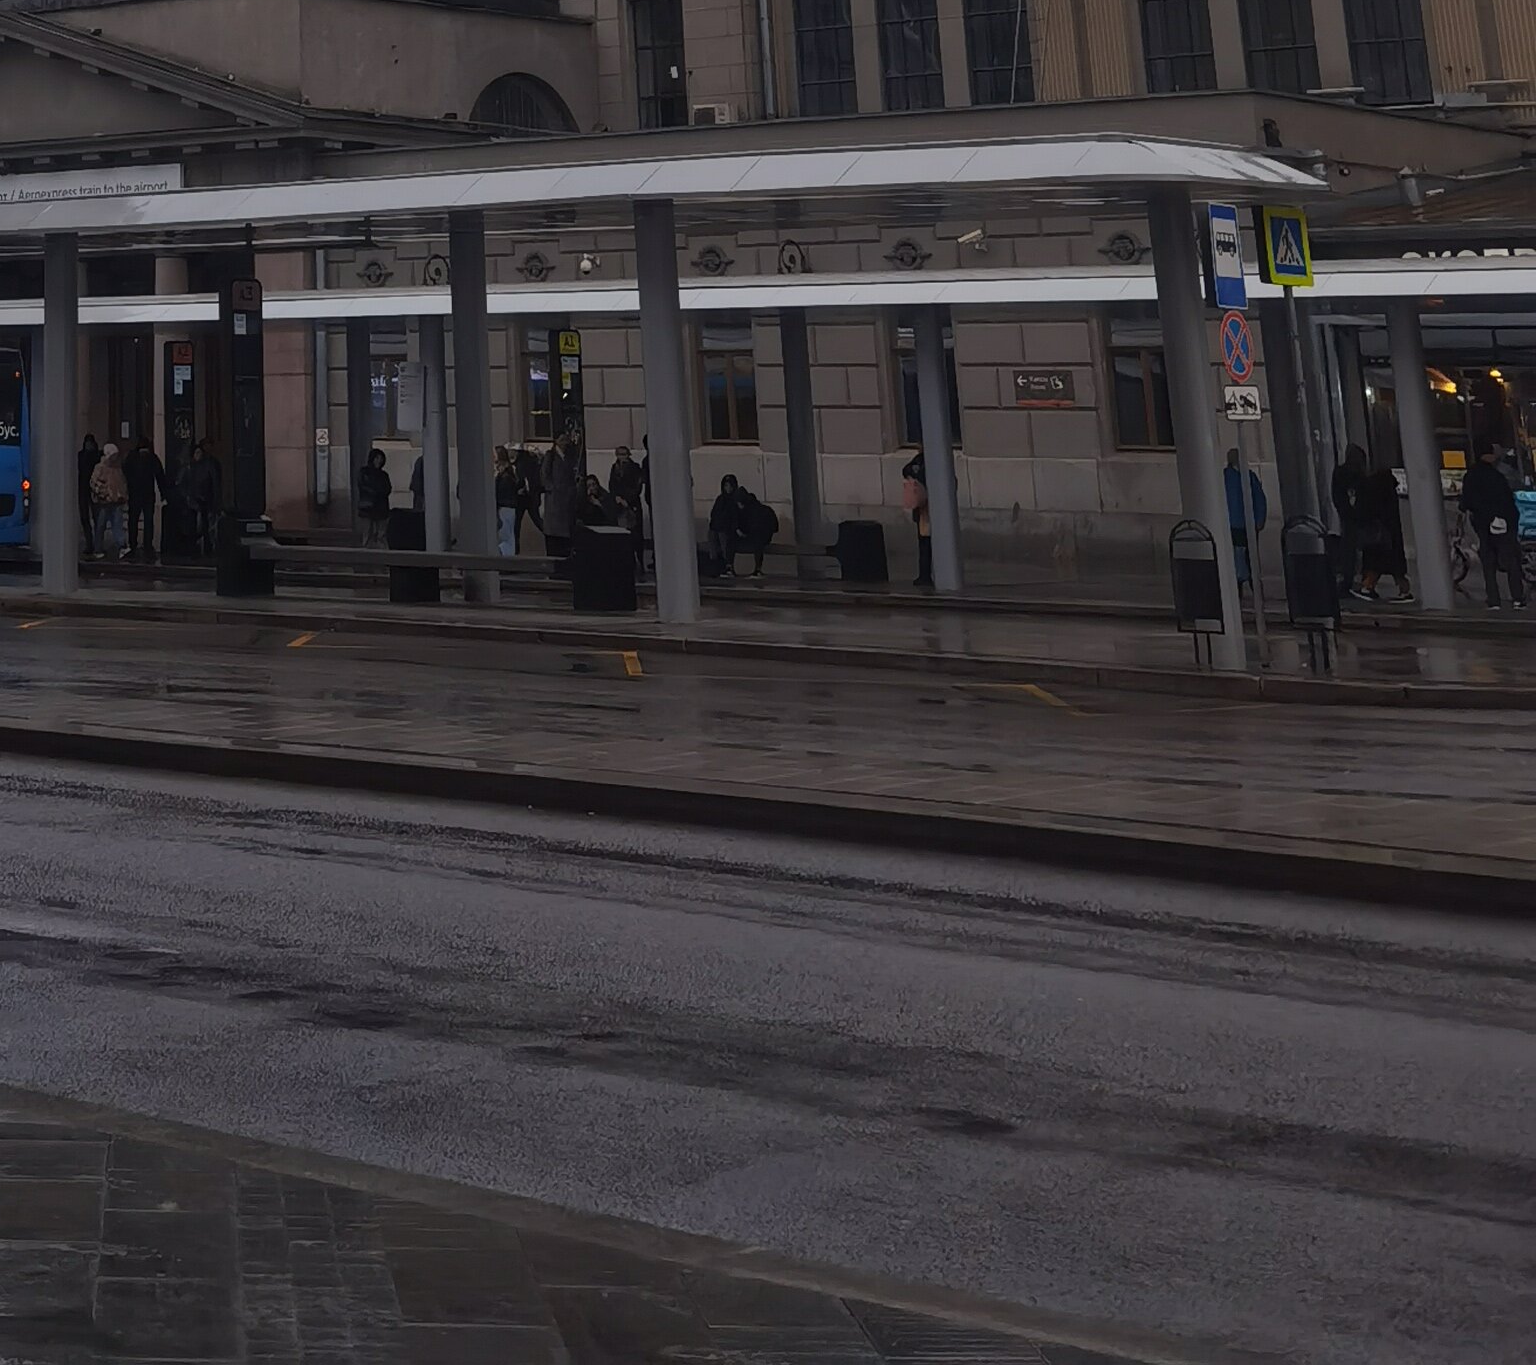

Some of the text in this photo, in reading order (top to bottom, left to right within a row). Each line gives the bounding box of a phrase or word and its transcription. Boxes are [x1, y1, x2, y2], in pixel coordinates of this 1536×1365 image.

[80, 184, 102, 195] train
[116, 181, 132, 193] the
[134, 180, 169, 192] airport
